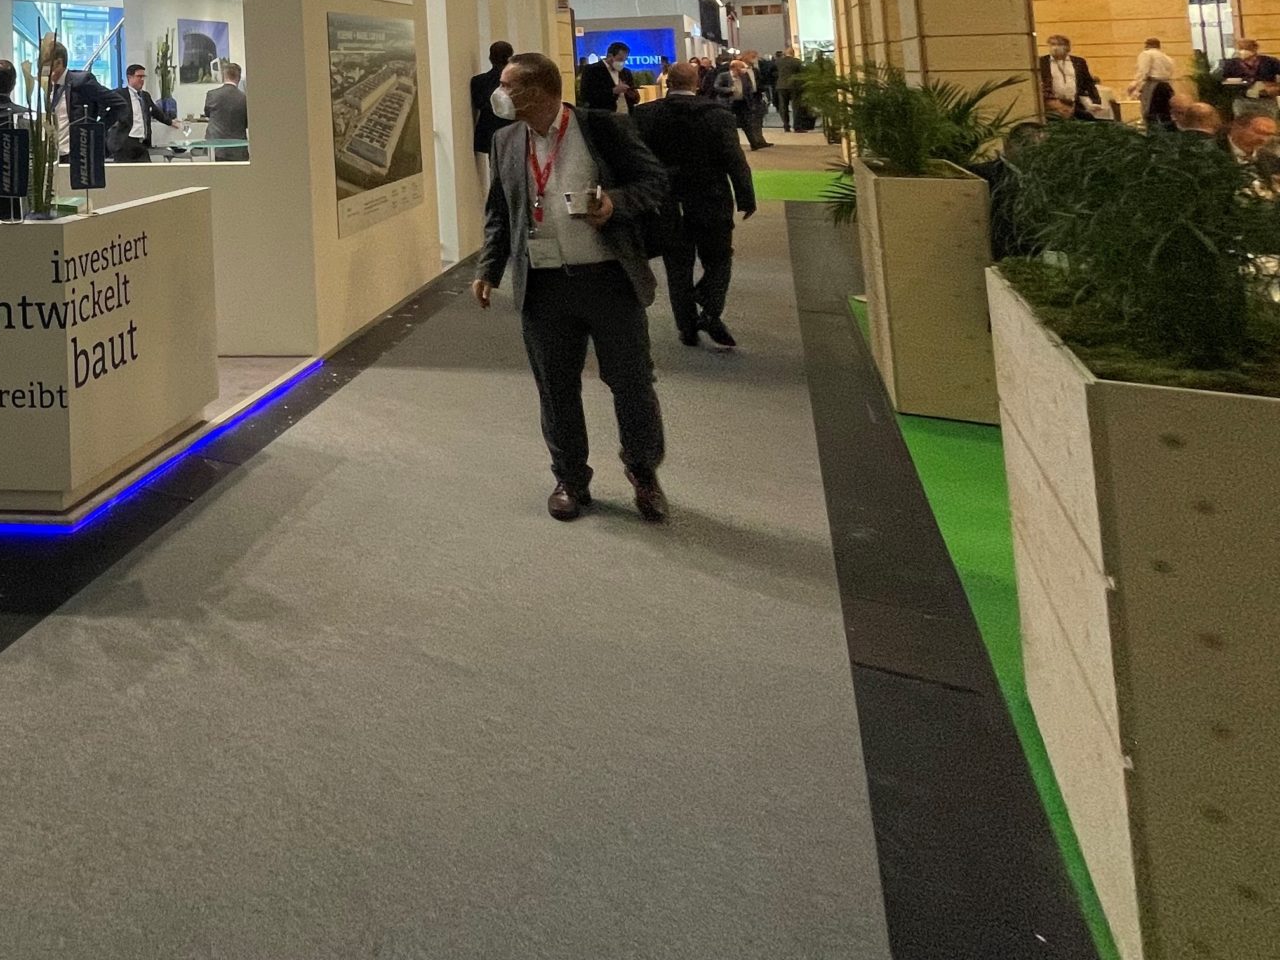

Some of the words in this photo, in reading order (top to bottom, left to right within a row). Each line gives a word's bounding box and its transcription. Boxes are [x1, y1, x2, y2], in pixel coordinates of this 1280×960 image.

[1, 133, 12, 193] HELLMICH
[79, 127, 89, 186] HELLMICH
[51, 231, 148, 283] investiert
[71, 319, 139, 389] baut
